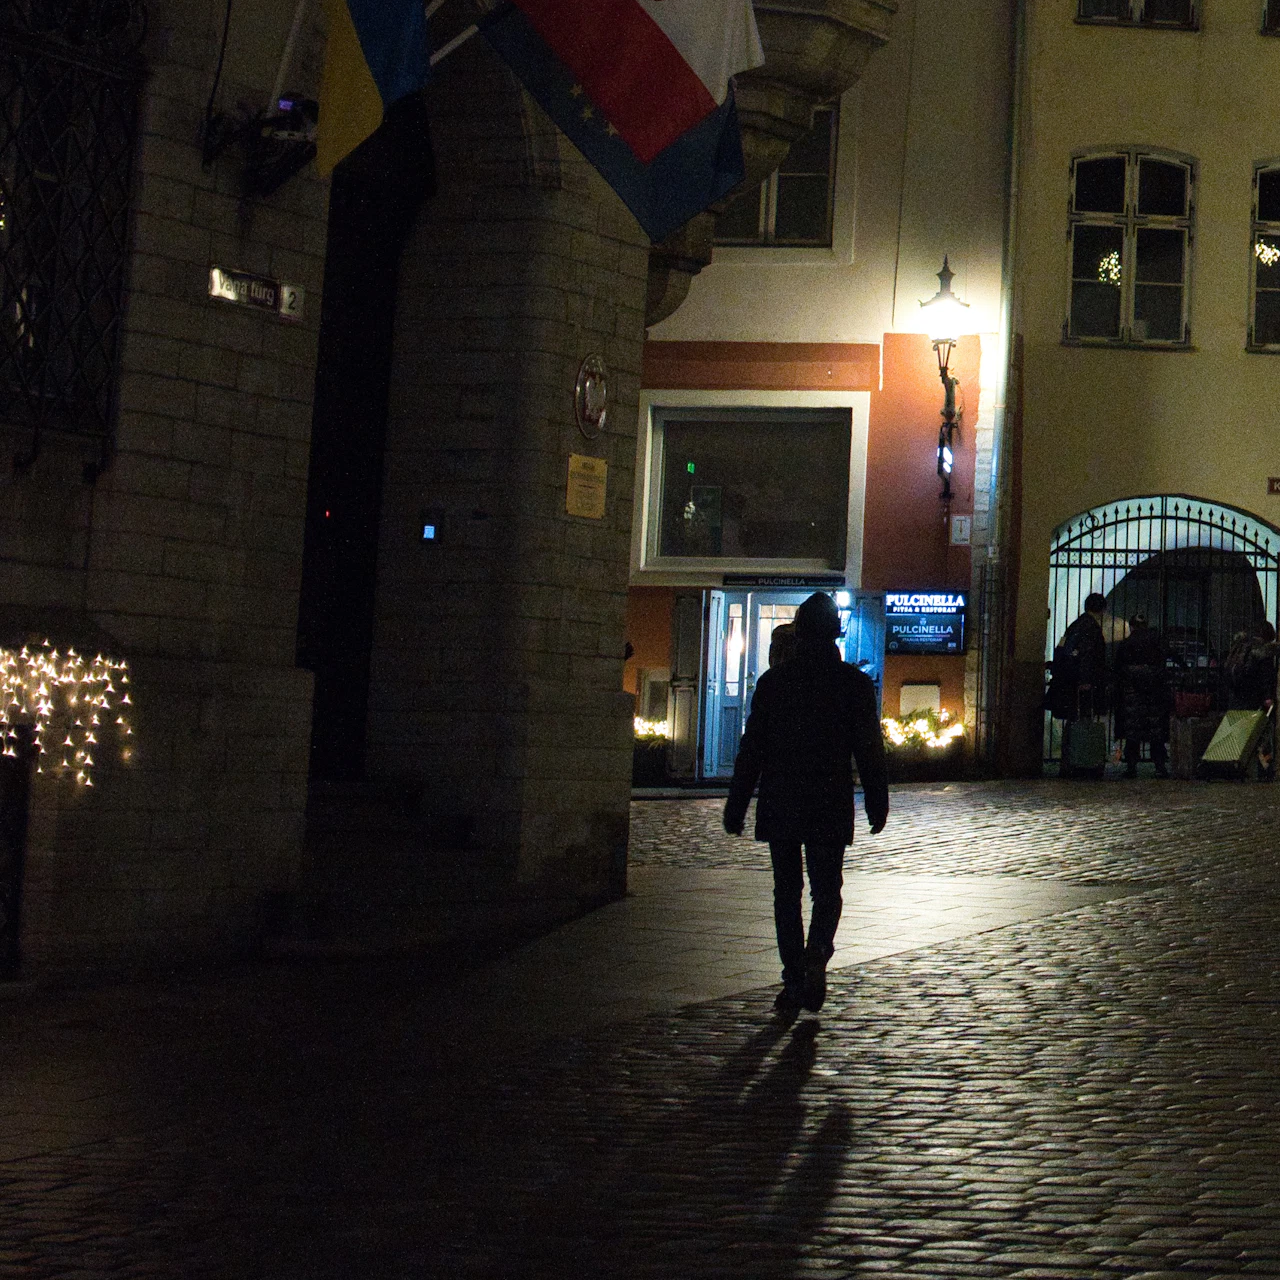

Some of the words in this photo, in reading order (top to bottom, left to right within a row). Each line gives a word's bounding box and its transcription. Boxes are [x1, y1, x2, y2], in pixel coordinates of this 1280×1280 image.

[218, 272, 249, 296] Vana
[288, 291, 297, 311] 2
[758, 578, 805, 586] PULCINELLA
[886, 594, 964, 607] PULCINELLA
[892, 625, 954, 634] PULCINELLA
